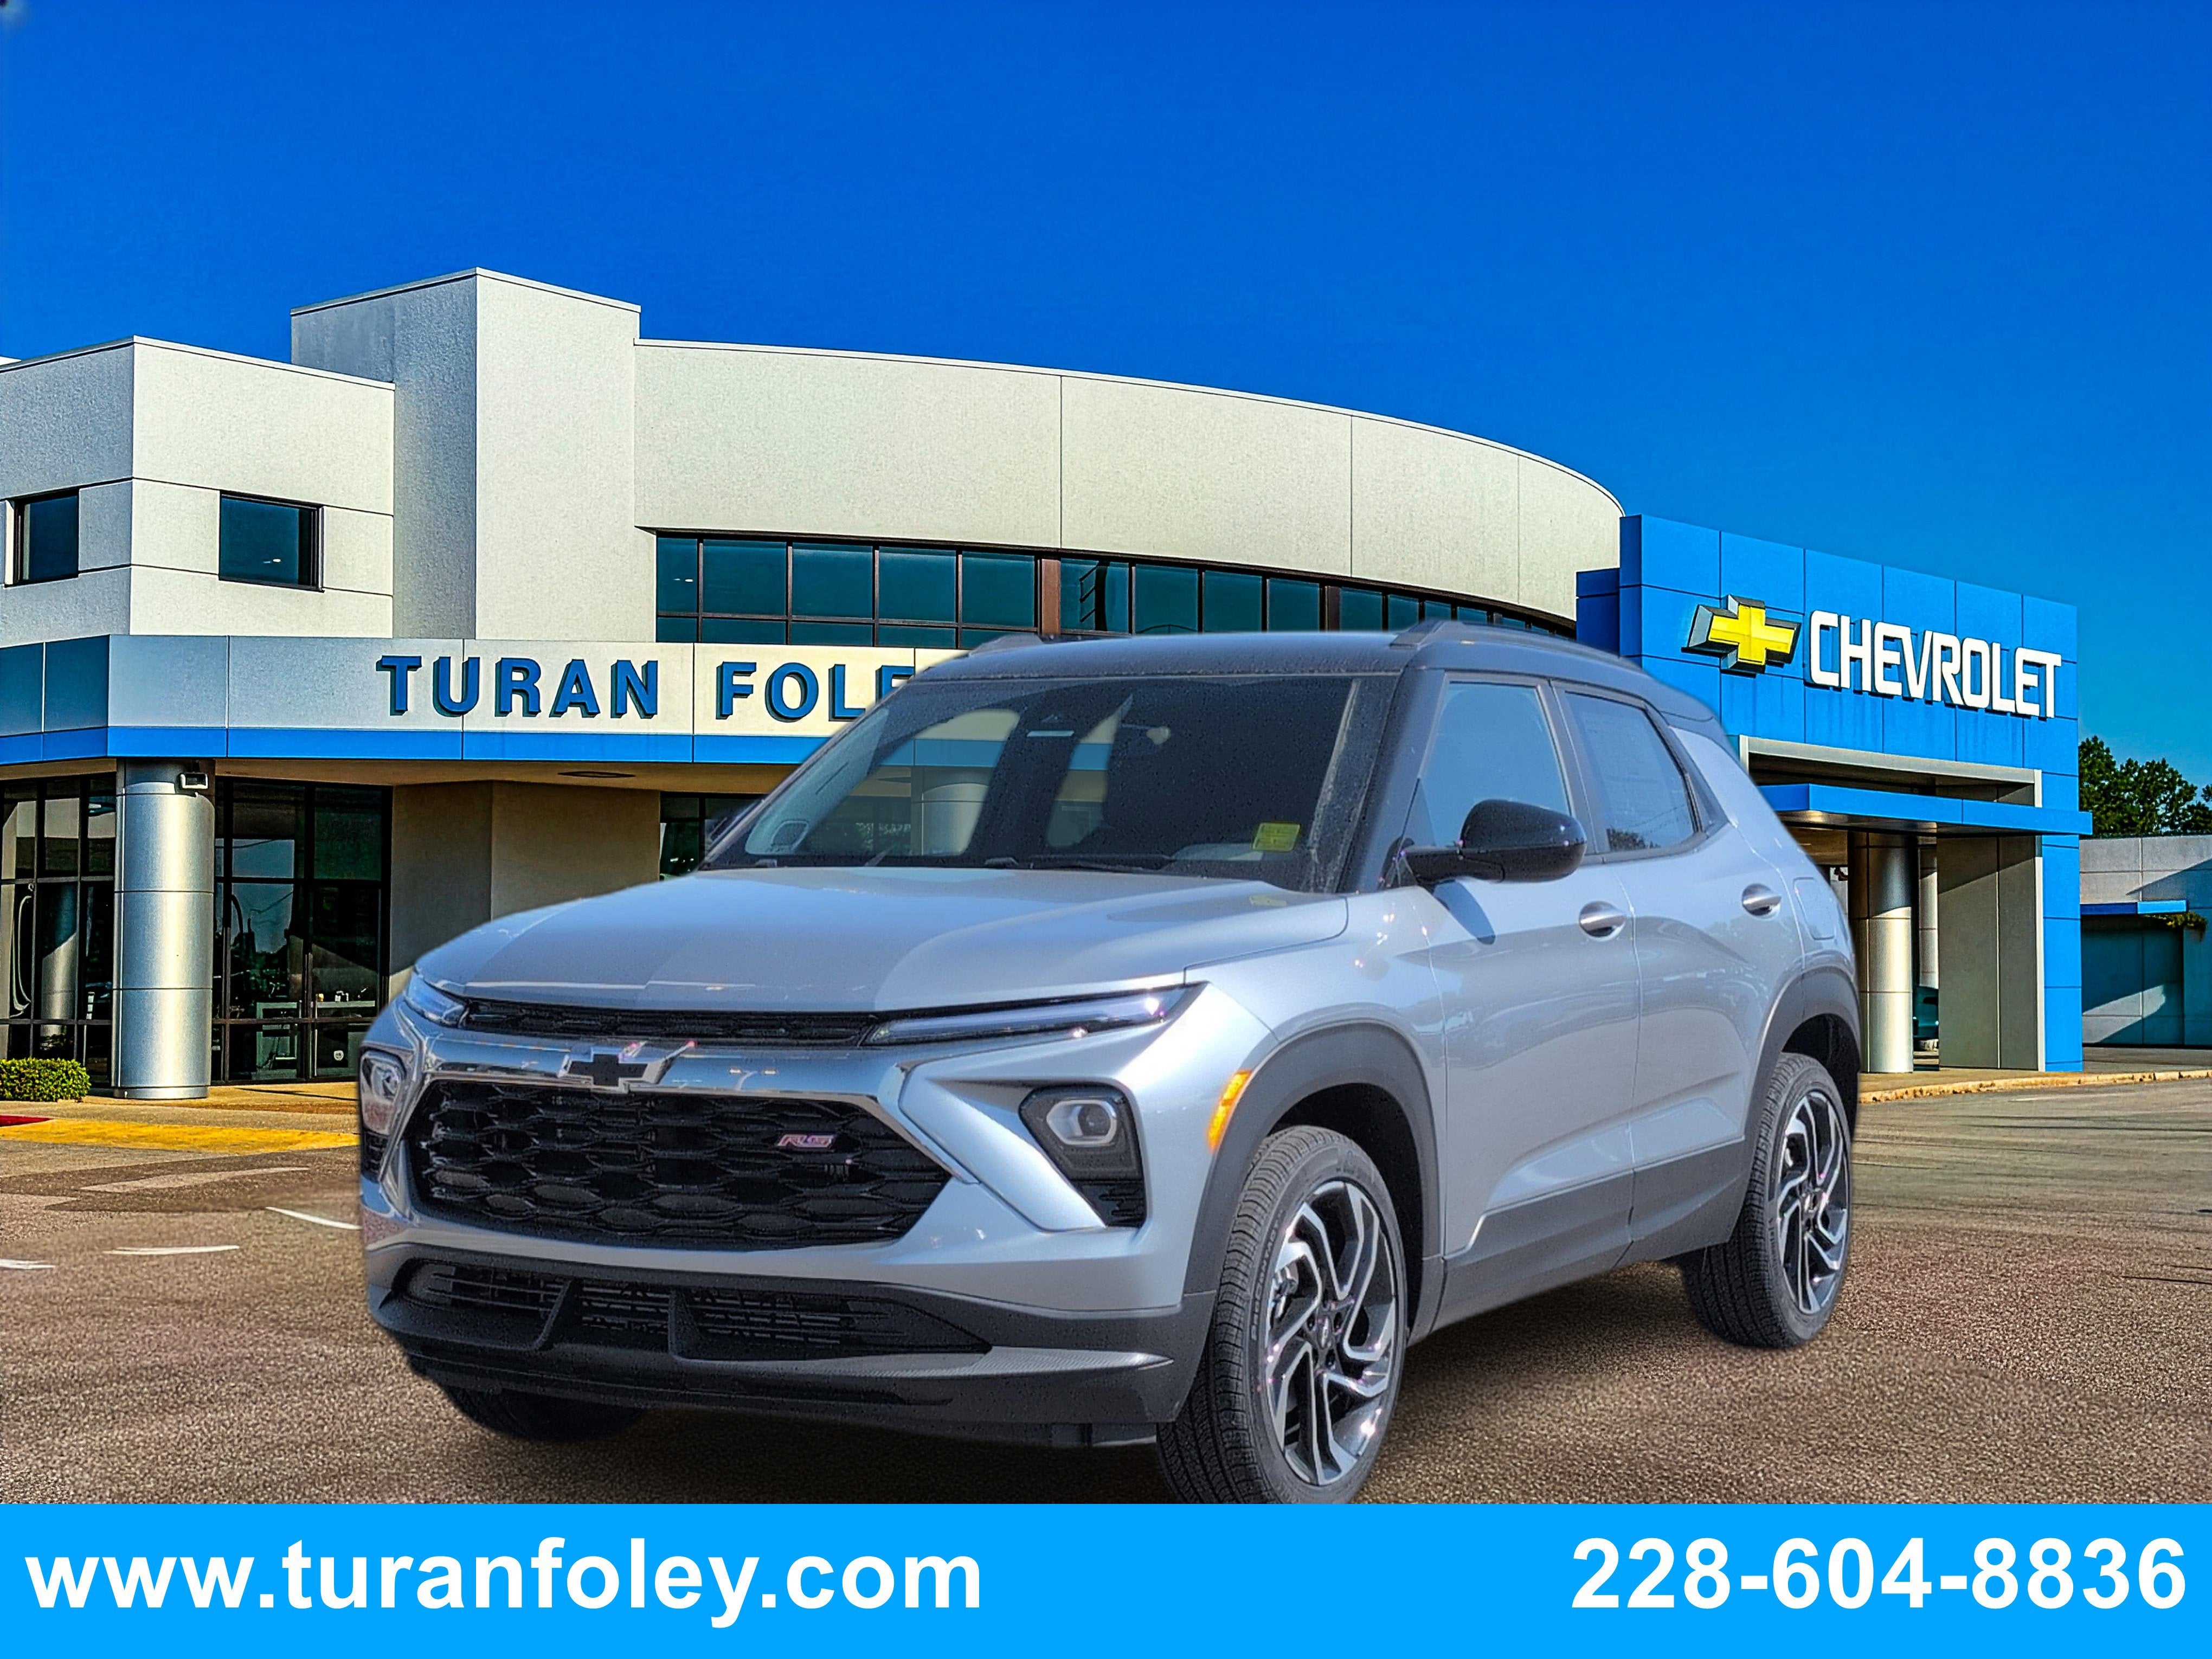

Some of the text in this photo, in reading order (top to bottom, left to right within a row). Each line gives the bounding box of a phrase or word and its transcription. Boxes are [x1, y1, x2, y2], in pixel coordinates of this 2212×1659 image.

[376, 655, 659, 719] TURAN
[1810, 609, 2062, 718] CHEVROLET
[776, 1133, 834, 1148] RS
